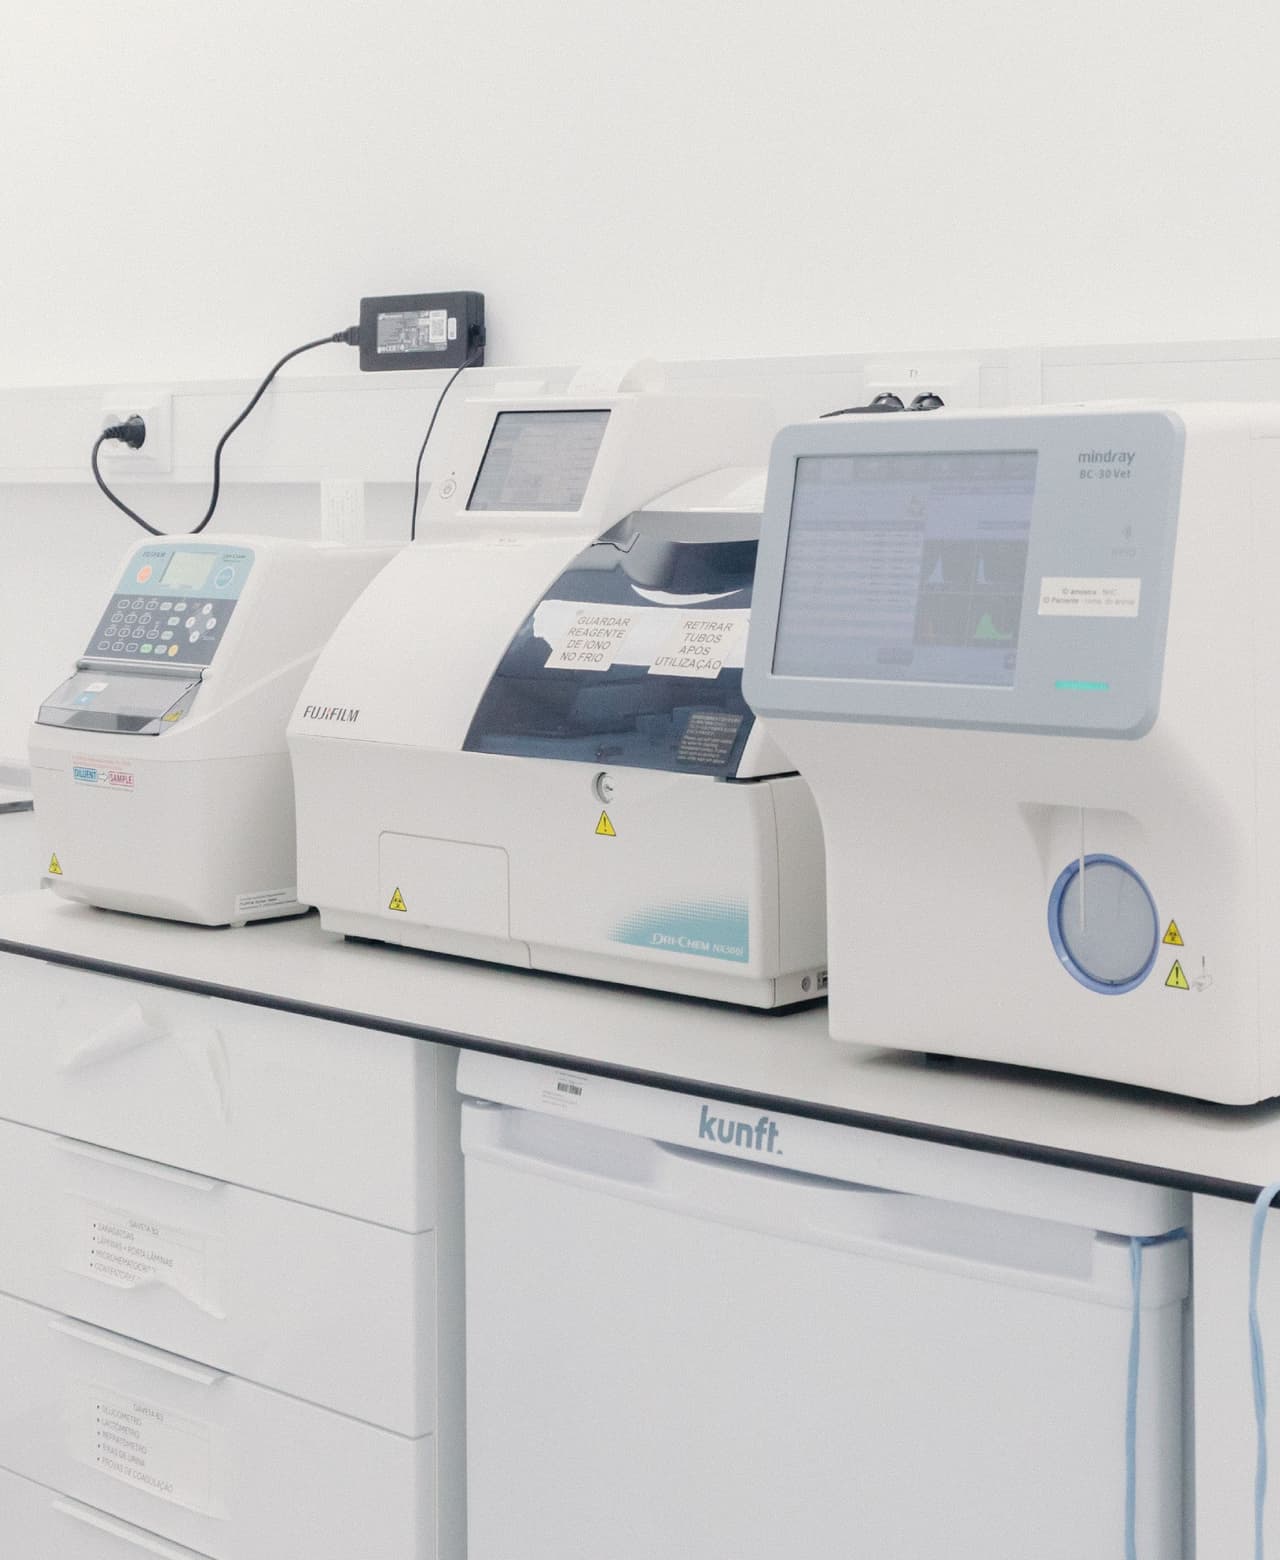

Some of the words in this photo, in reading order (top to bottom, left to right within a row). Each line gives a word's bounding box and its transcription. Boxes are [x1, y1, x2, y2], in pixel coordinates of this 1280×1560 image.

[1077, 450, 1136, 466] mindray
[1113, 469, 1132, 479] Vet
[577, 615, 631, 627] GUARDAR
[683, 620, 734, 632] RETIRAR
[568, 627, 626, 639] REAGENTE
[684, 632, 723, 644] TUBOS
[567, 639, 583, 649] DE
[560, 652, 577, 662] NO
[577, 652, 604, 663] FRIO
[654, 656, 722, 671] UTILIZAÇÃO
[303, 705, 360, 722] FUJIFILM
